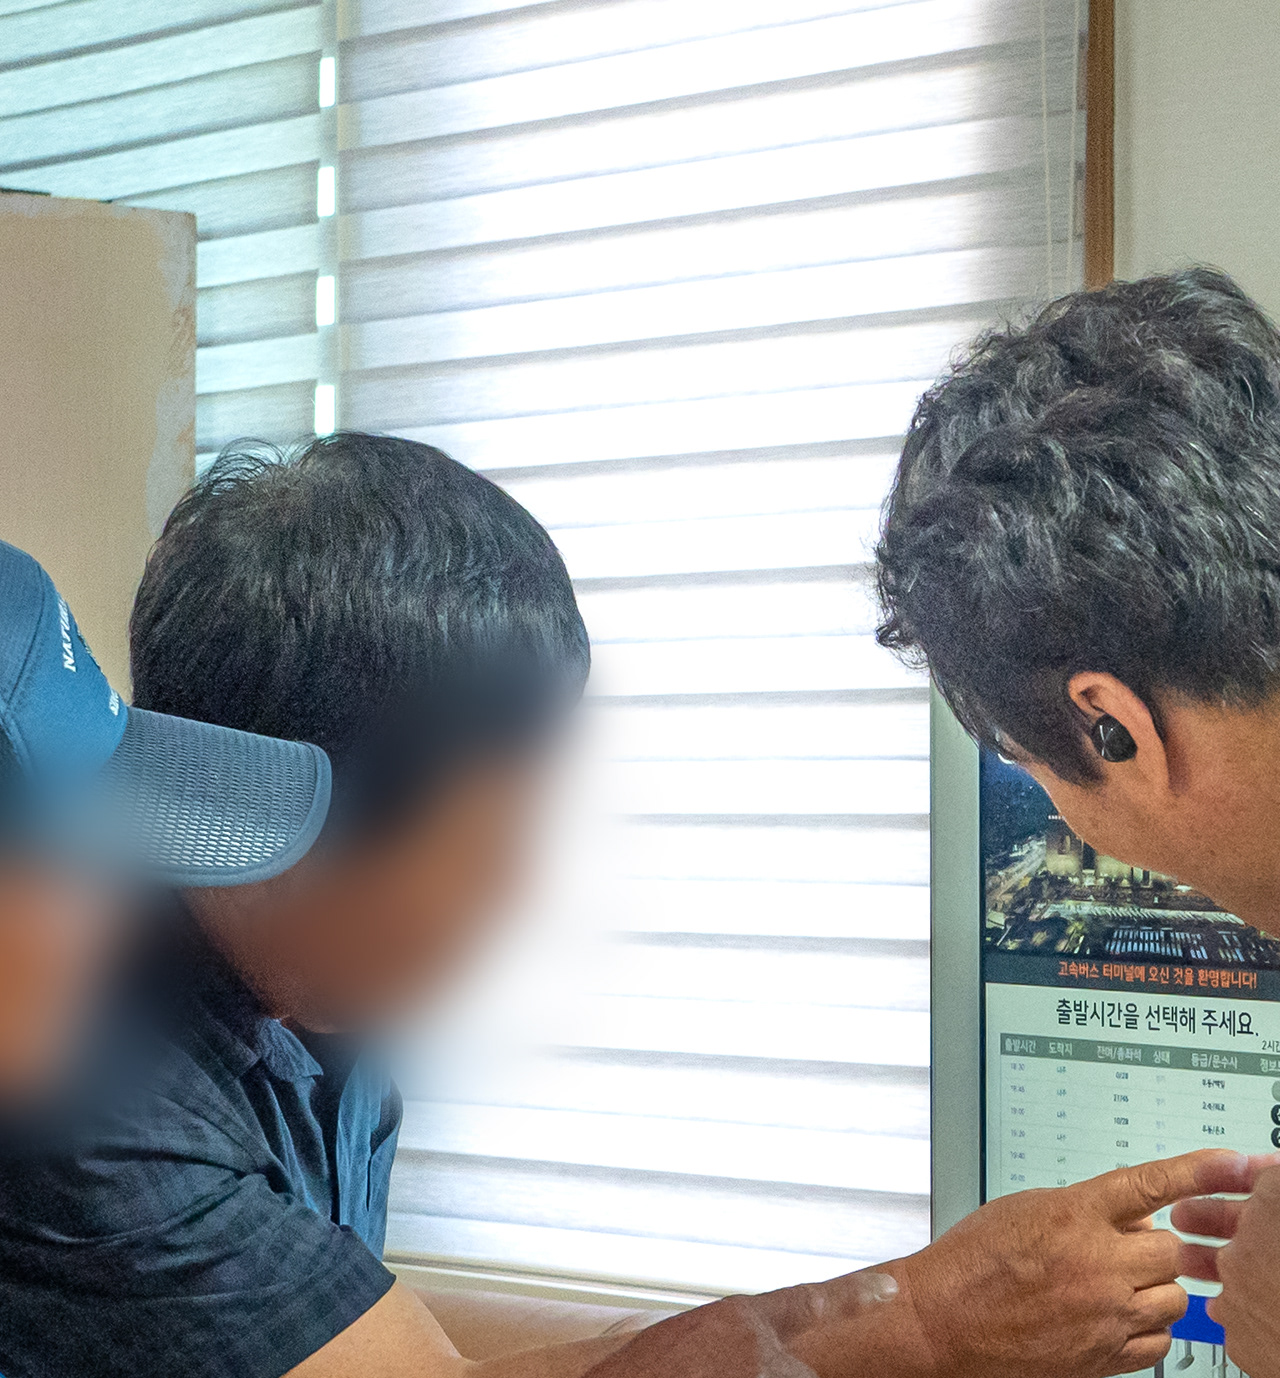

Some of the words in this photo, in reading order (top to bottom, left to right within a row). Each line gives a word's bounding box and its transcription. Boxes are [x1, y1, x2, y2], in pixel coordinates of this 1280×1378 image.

[1058, 961, 1100, 980] 고속버스
[1102, 964, 1146, 983] 터미널에
[1148, 966, 1170, 984] 오신
[1173, 967, 1194, 986] 것을
[1197, 968, 1257, 989] 환영합니다!
[1056, 998, 1140, 1030] 출발시간을
[1145, 1005, 1196, 1034] 선택해
[1201, 1009, 1259, 1037] 주세요.
